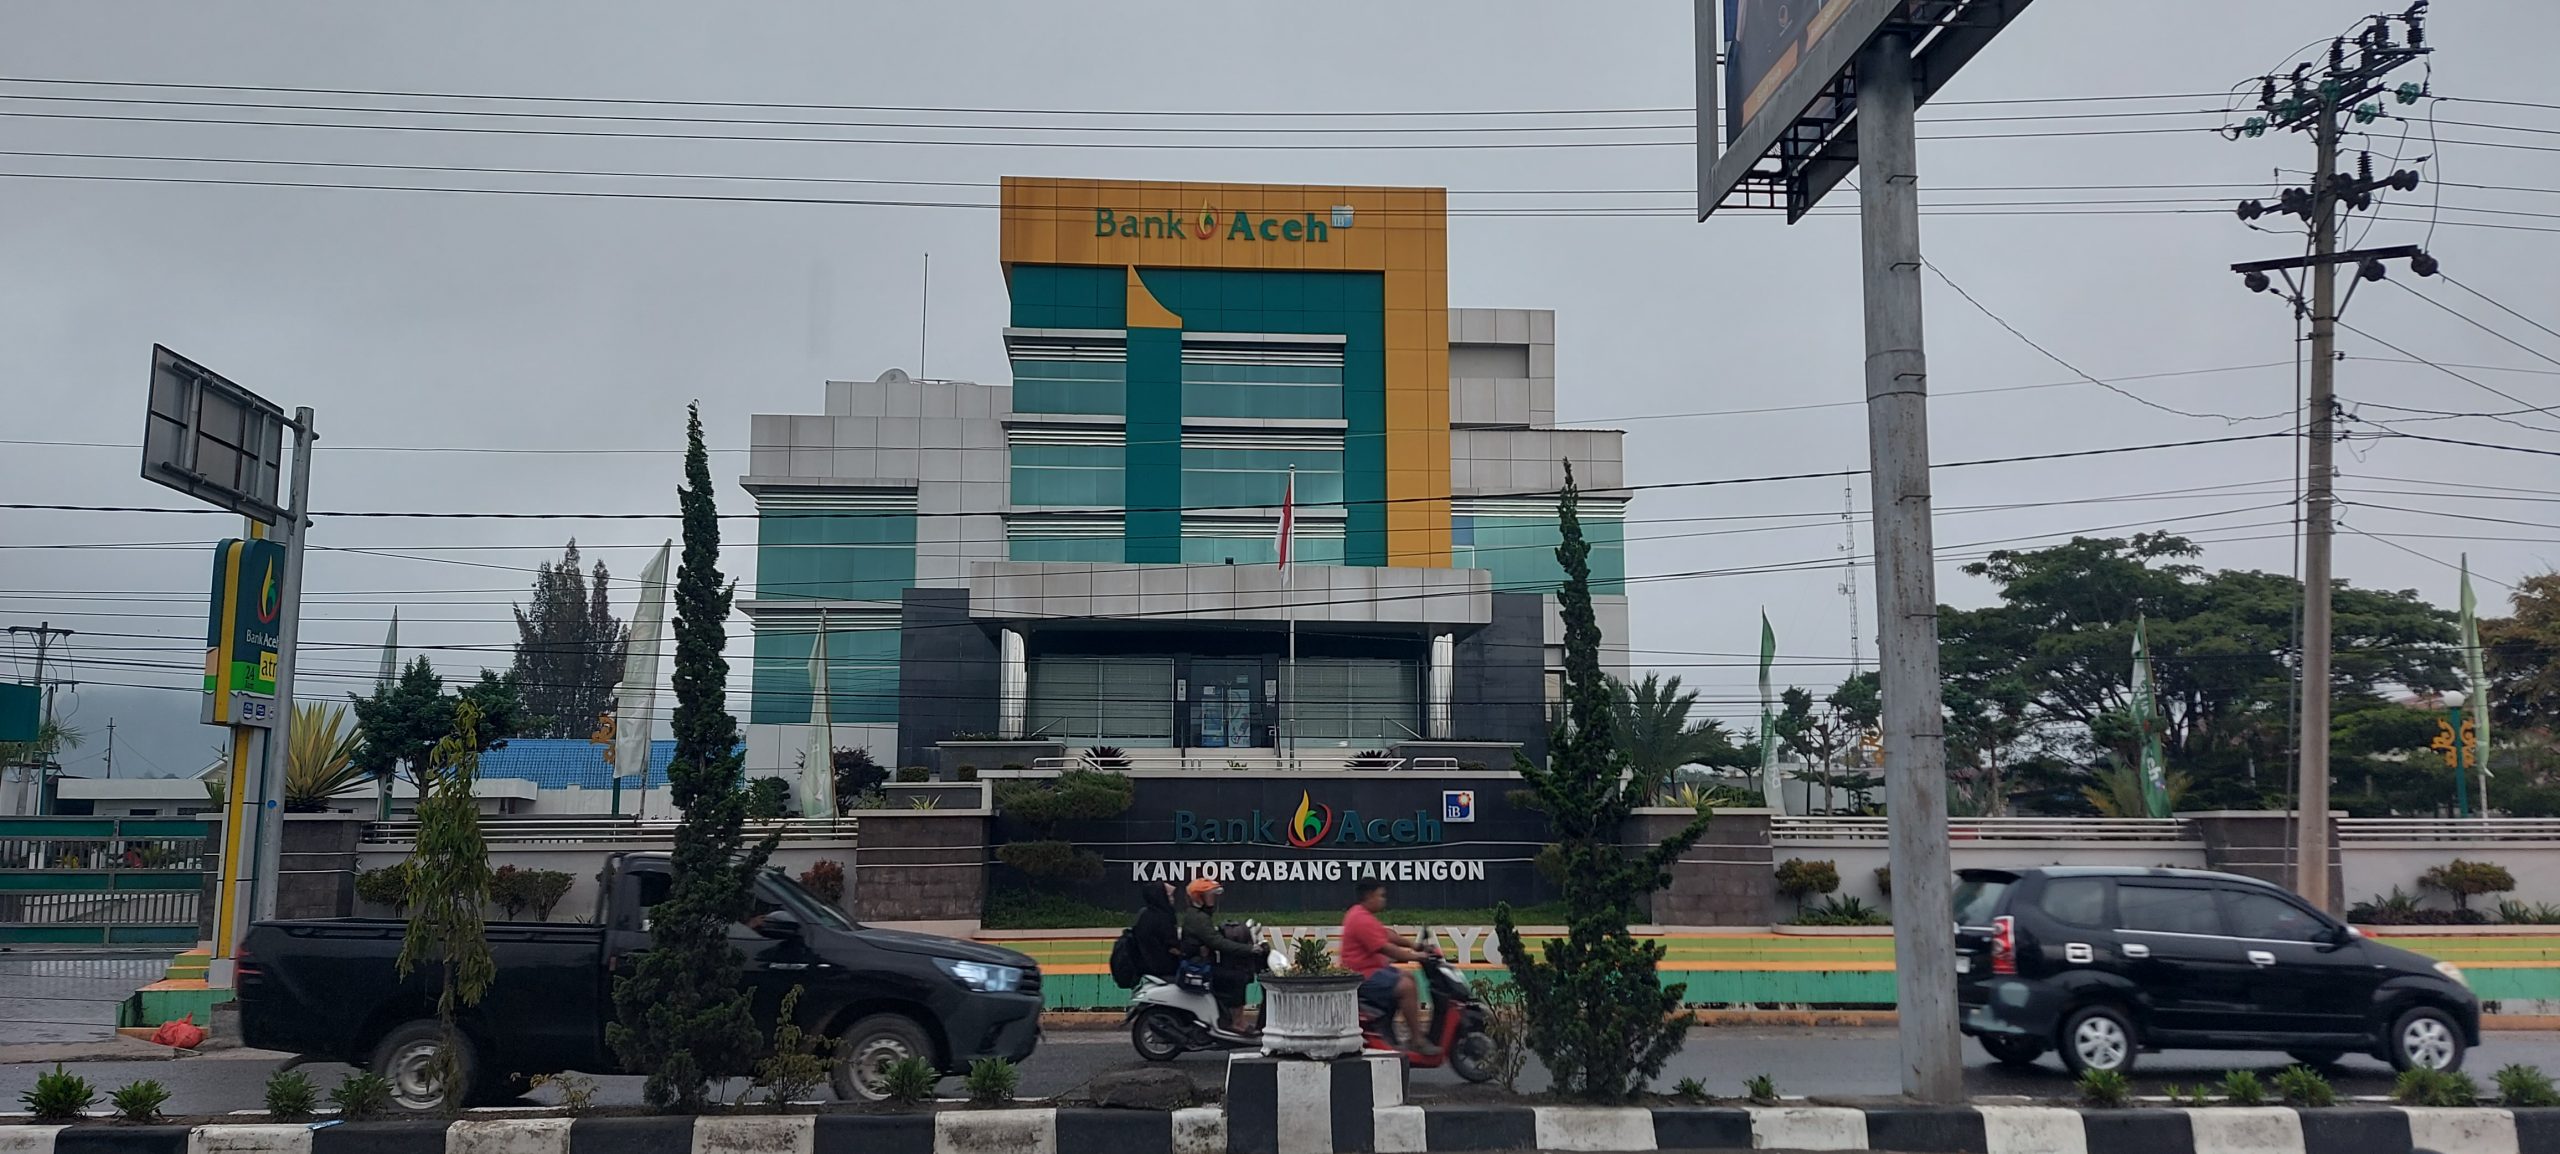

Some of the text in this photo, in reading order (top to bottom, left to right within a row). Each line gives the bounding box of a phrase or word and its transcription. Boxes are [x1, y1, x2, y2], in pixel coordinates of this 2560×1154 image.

[1096, 207, 1328, 243] Bank Aceh
[246, 629, 262, 645] Bank
[245, 665, 255, 681] 24
[1448, 805, 1461, 818] iB
[1175, 809, 1442, 843] Bank Aceh
[1132, 861, 1485, 881] KANTOR CABANG TAKENGON
